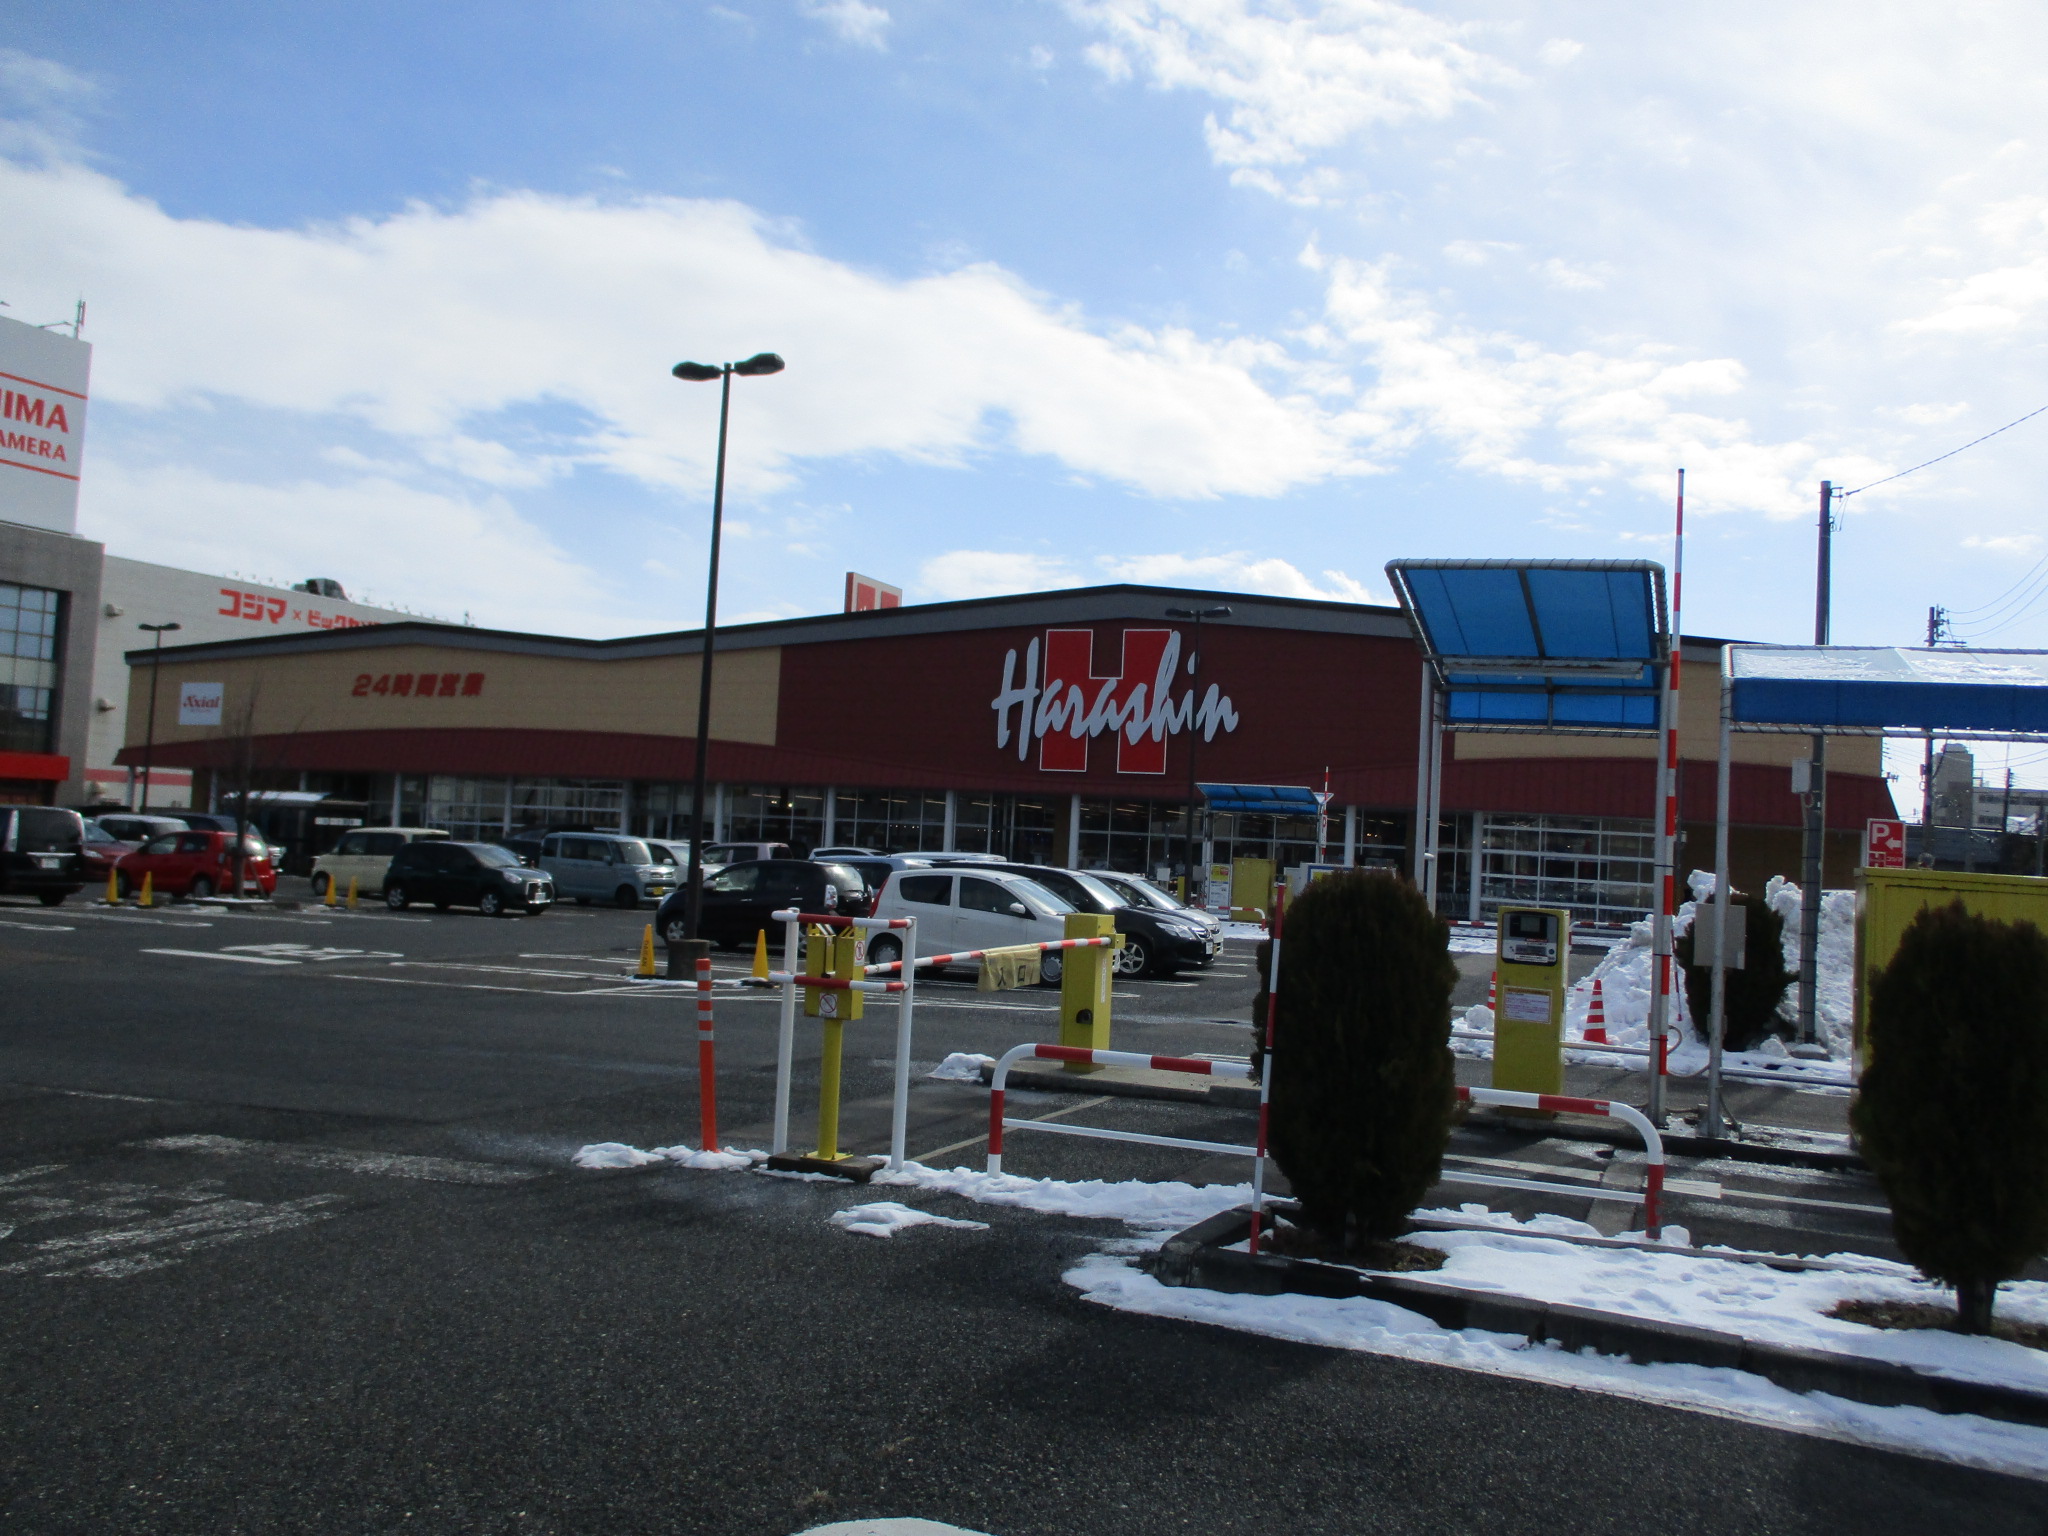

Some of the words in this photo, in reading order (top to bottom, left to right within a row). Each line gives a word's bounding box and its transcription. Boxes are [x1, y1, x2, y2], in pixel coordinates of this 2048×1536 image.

[0, 388, 69, 433] IMA
[218, 588, 287, 624] コジマ
[991, 630, 1239, 761] Harashin
[1872, 823, 1890, 844] P
